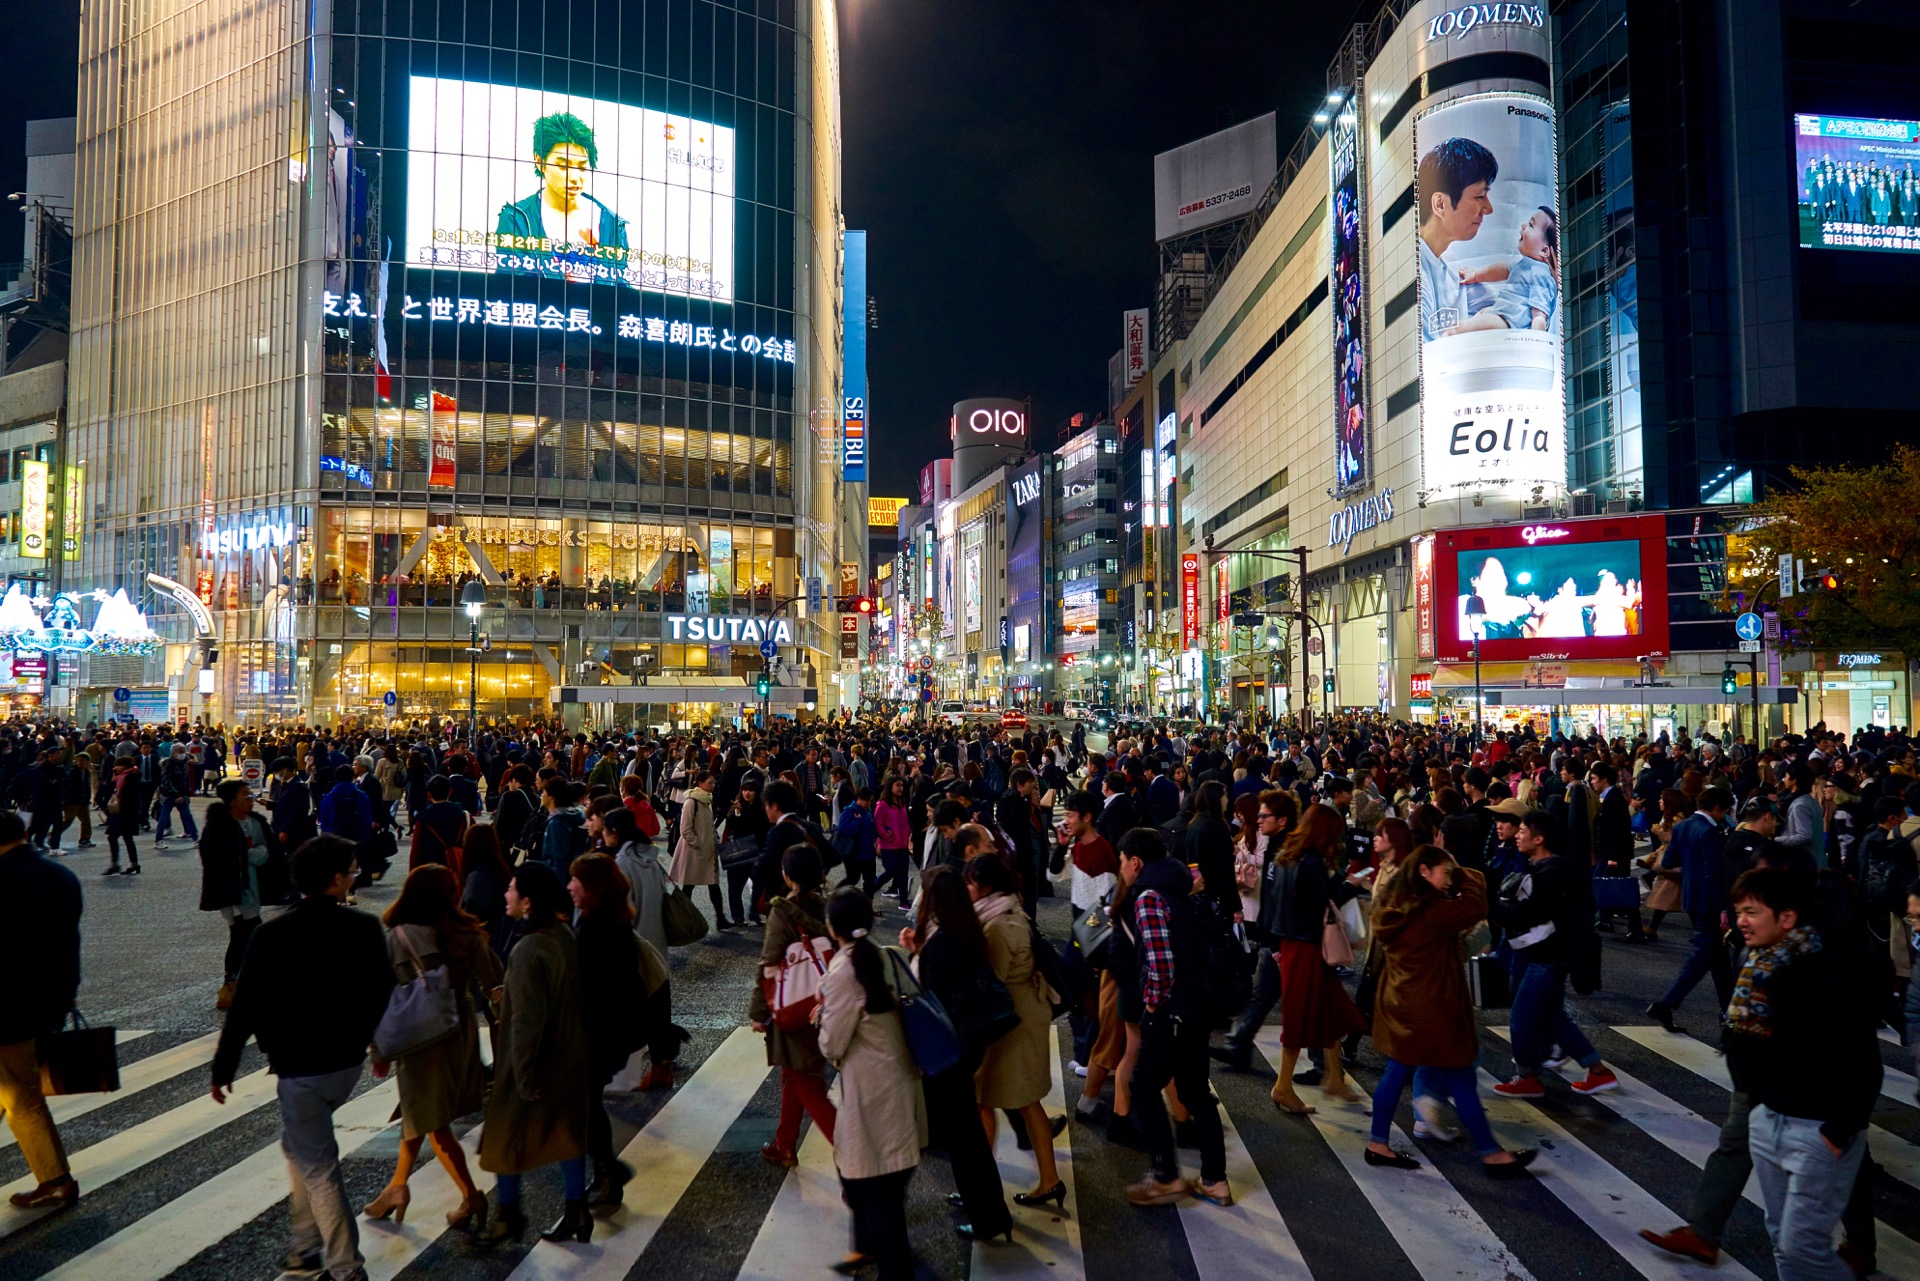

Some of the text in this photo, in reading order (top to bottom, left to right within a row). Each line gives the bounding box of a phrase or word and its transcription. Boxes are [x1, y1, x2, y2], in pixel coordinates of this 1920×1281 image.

[1507, 105, 1550, 124] Panasonic
[1179, 185, 1251, 216] 広告募集 5337-2468
[1129, 315, 1144, 370] 大和証券
[1449, 418, 1549, 456] Eolia
[1012, 470, 1040, 506] ZARA
[868, 499, 897, 512] TOWER
[868, 512, 898, 524] ECORD
[26, 536, 40, 547] 4F
[433, 525, 694, 553] STARBUCKS COFFEE
[1522, 526, 1569, 544] Glico
[668, 616, 791, 642] TSUTAYA
[844, 619, 855, 630] 本
